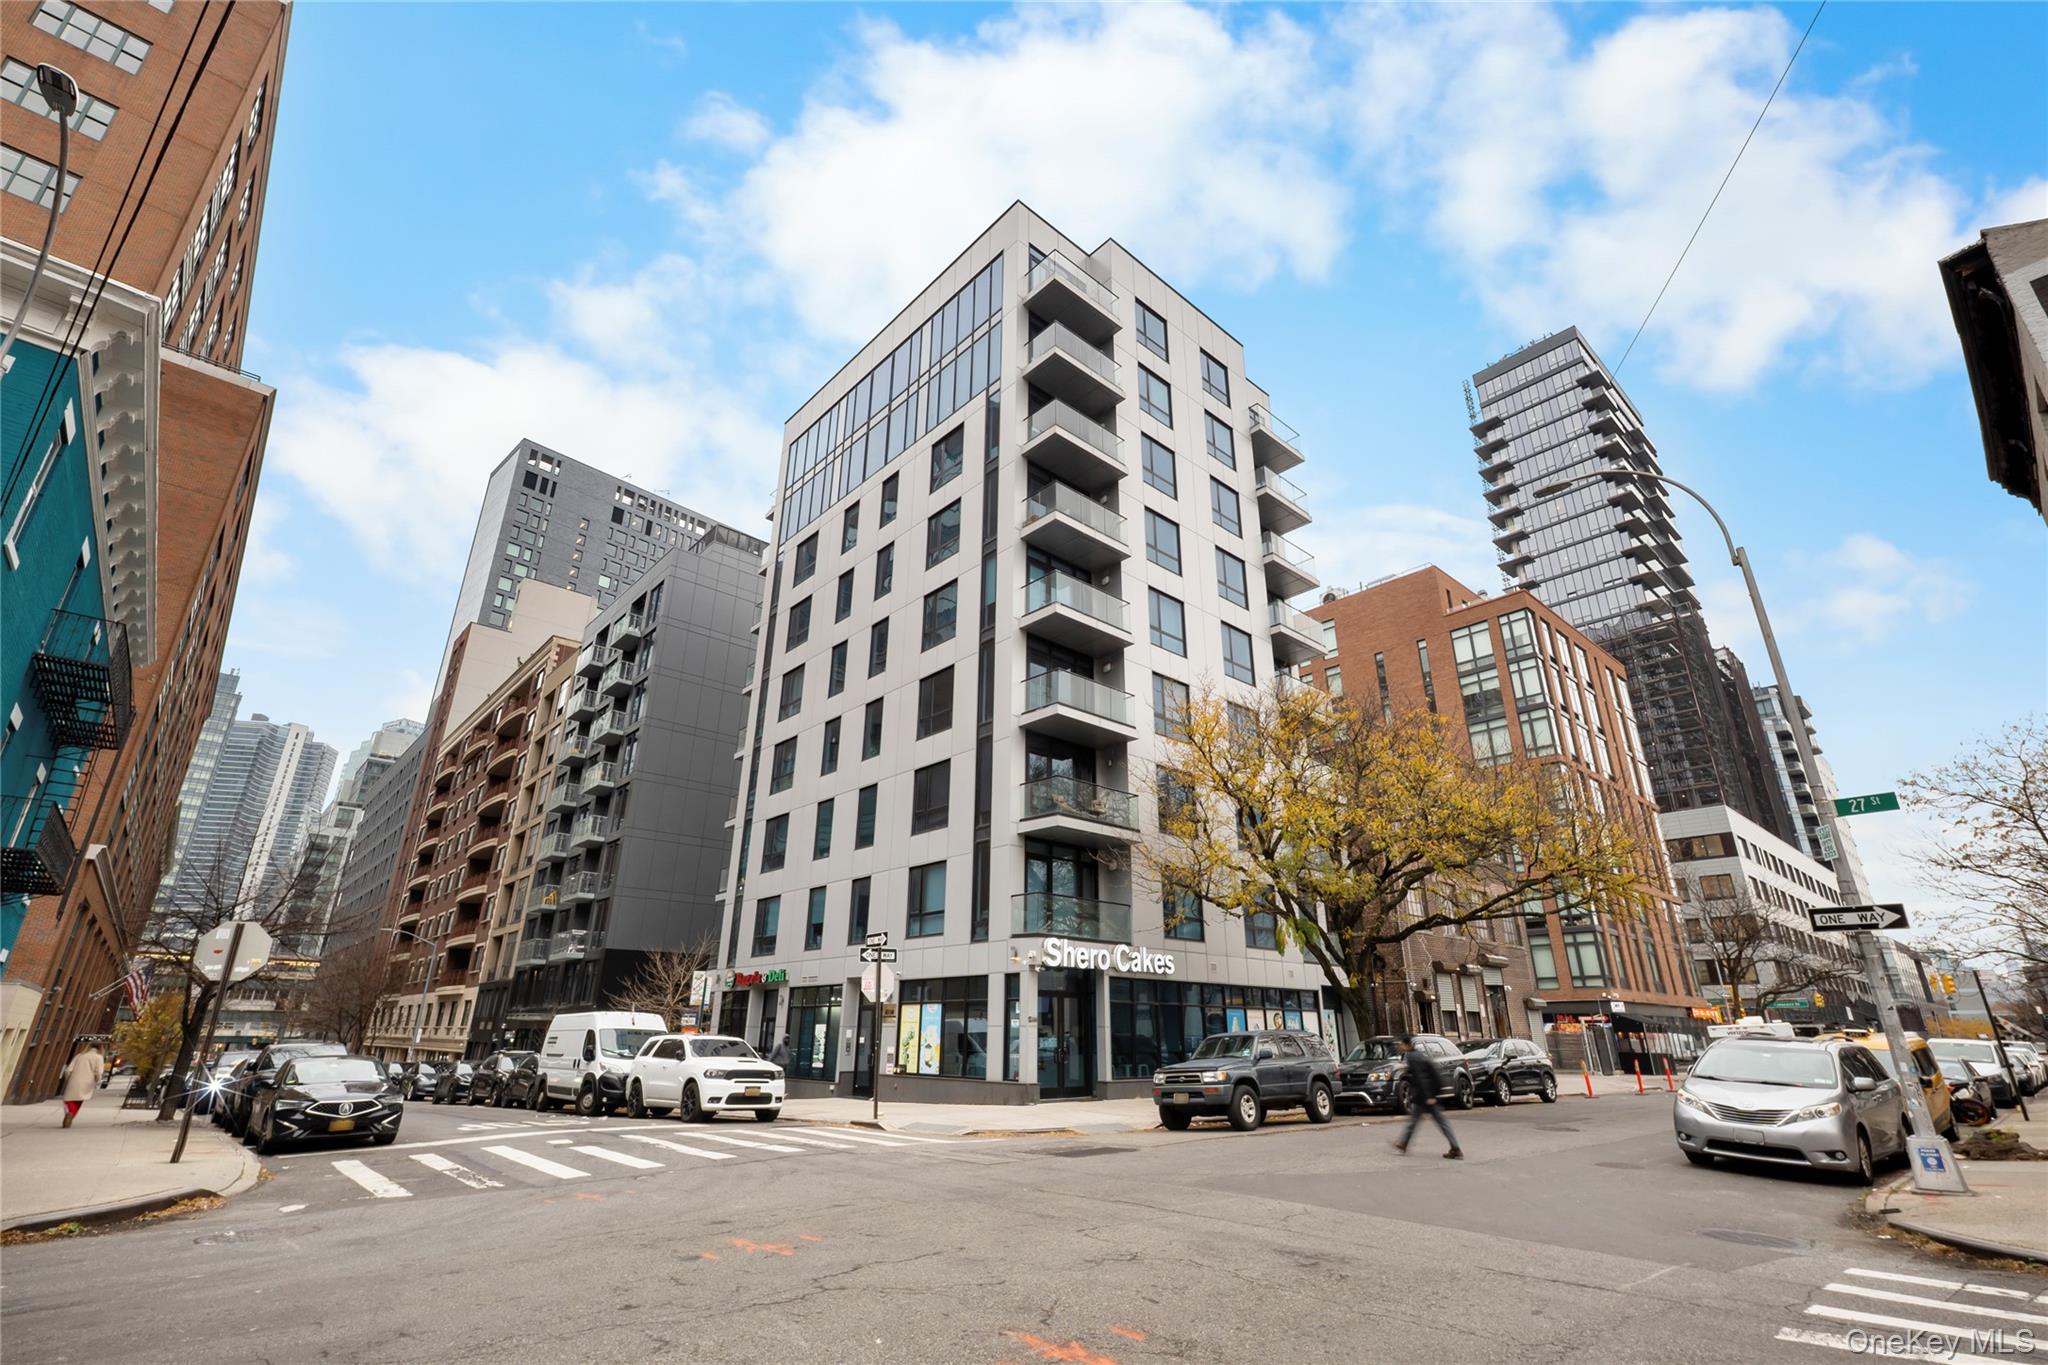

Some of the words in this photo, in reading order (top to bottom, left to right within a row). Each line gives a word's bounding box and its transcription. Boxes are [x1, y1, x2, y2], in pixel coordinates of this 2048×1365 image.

[1848, 798, 1865, 813] 27
[1820, 914, 1846, 925] ONE
[1857, 911, 1886, 923] WAY
[1043, 937, 1111, 970] Shero
[1114, 943, 1176, 975] Cakes
[768, 969, 785, 983] Deli
